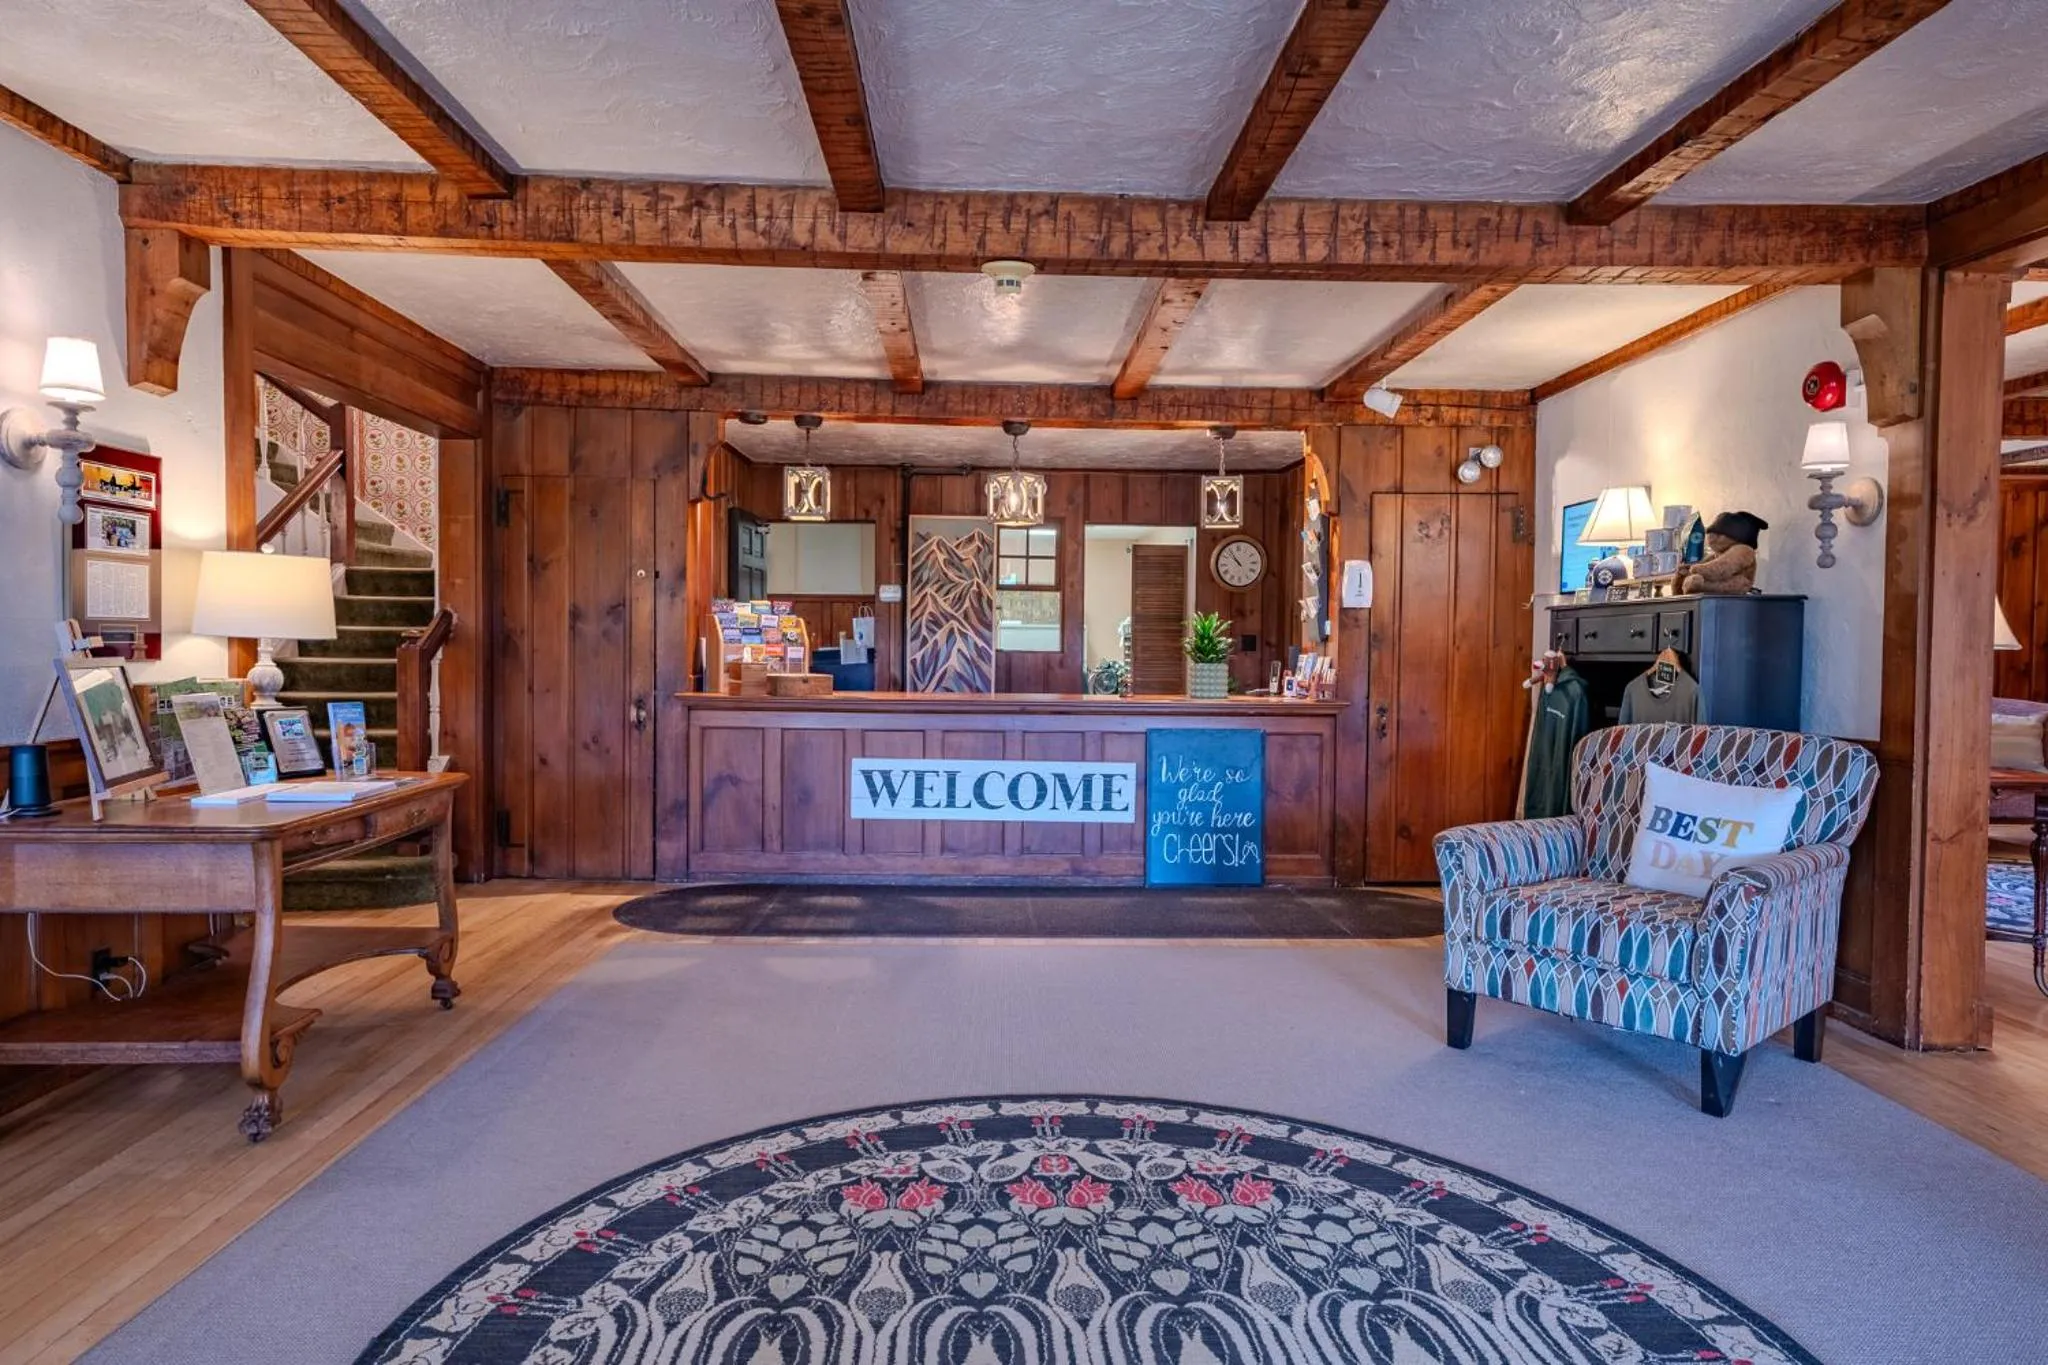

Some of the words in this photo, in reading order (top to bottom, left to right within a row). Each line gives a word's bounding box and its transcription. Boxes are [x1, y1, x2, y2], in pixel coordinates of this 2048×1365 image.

[1160, 755, 1216, 782] We're
[1224, 768, 1252, 783] so
[858, 769, 1129, 811] WELCOME
[1177, 782, 1224, 811] glad
[1151, 809, 1204, 837] you're
[1211, 801, 1256, 828] here
[1646, 805, 1755, 848] BEST
[1649, 839, 1730, 880] DAY
